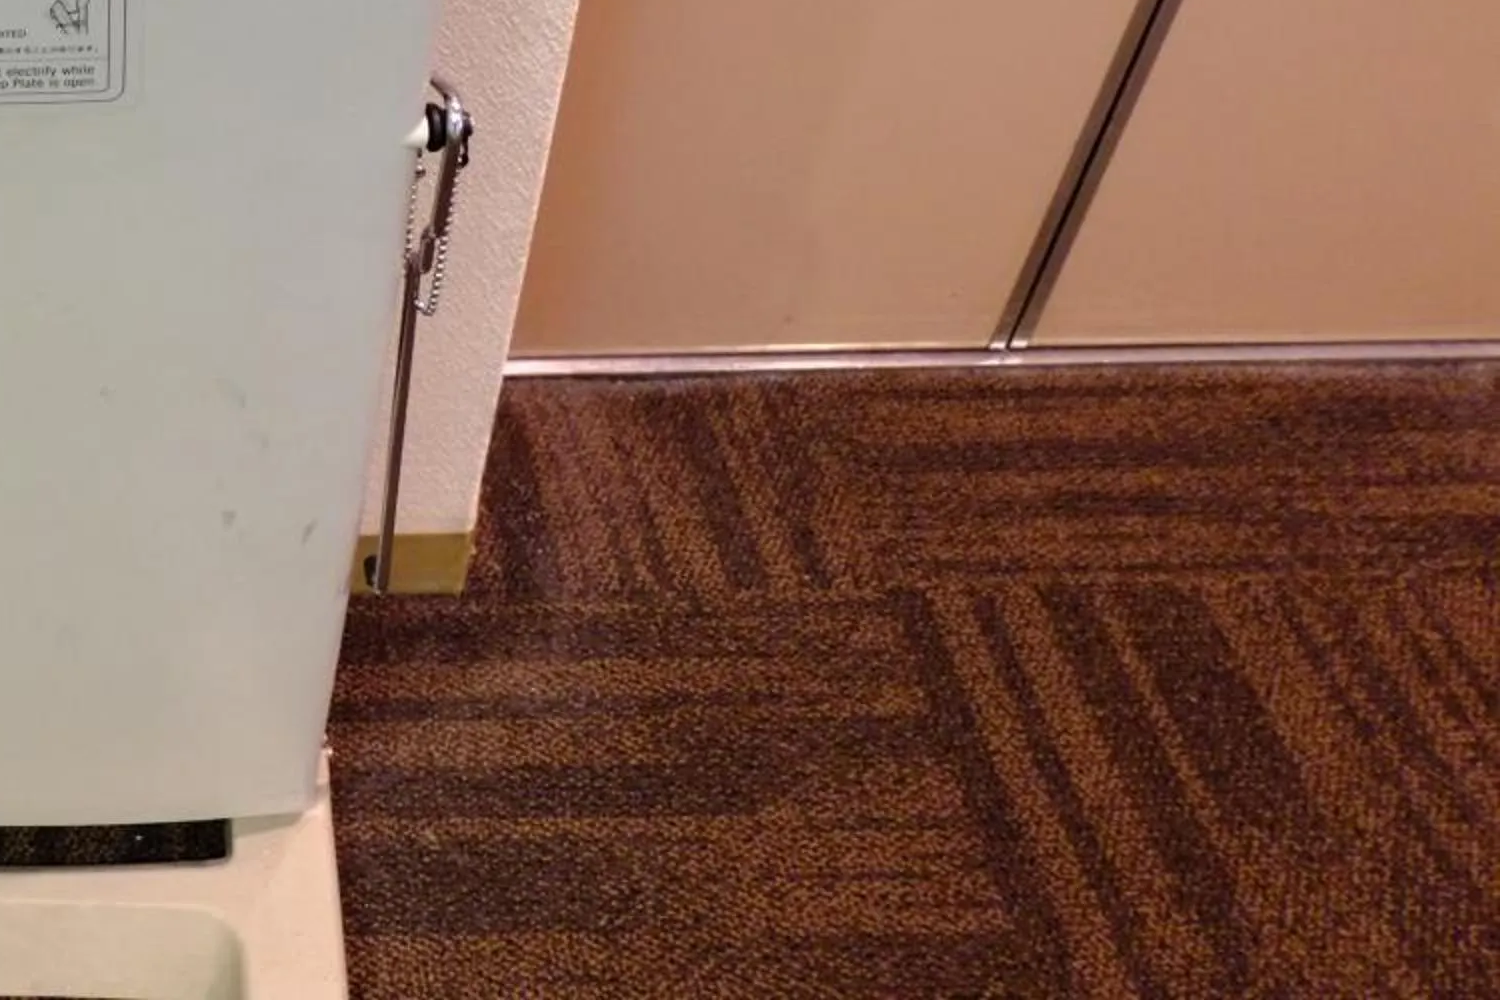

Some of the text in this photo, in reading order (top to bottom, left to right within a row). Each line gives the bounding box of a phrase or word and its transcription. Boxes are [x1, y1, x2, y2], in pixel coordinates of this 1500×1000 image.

[6, 66, 57, 78] electrify
[61, 64, 96, 76] while
[13, 77, 45, 89] Plate
